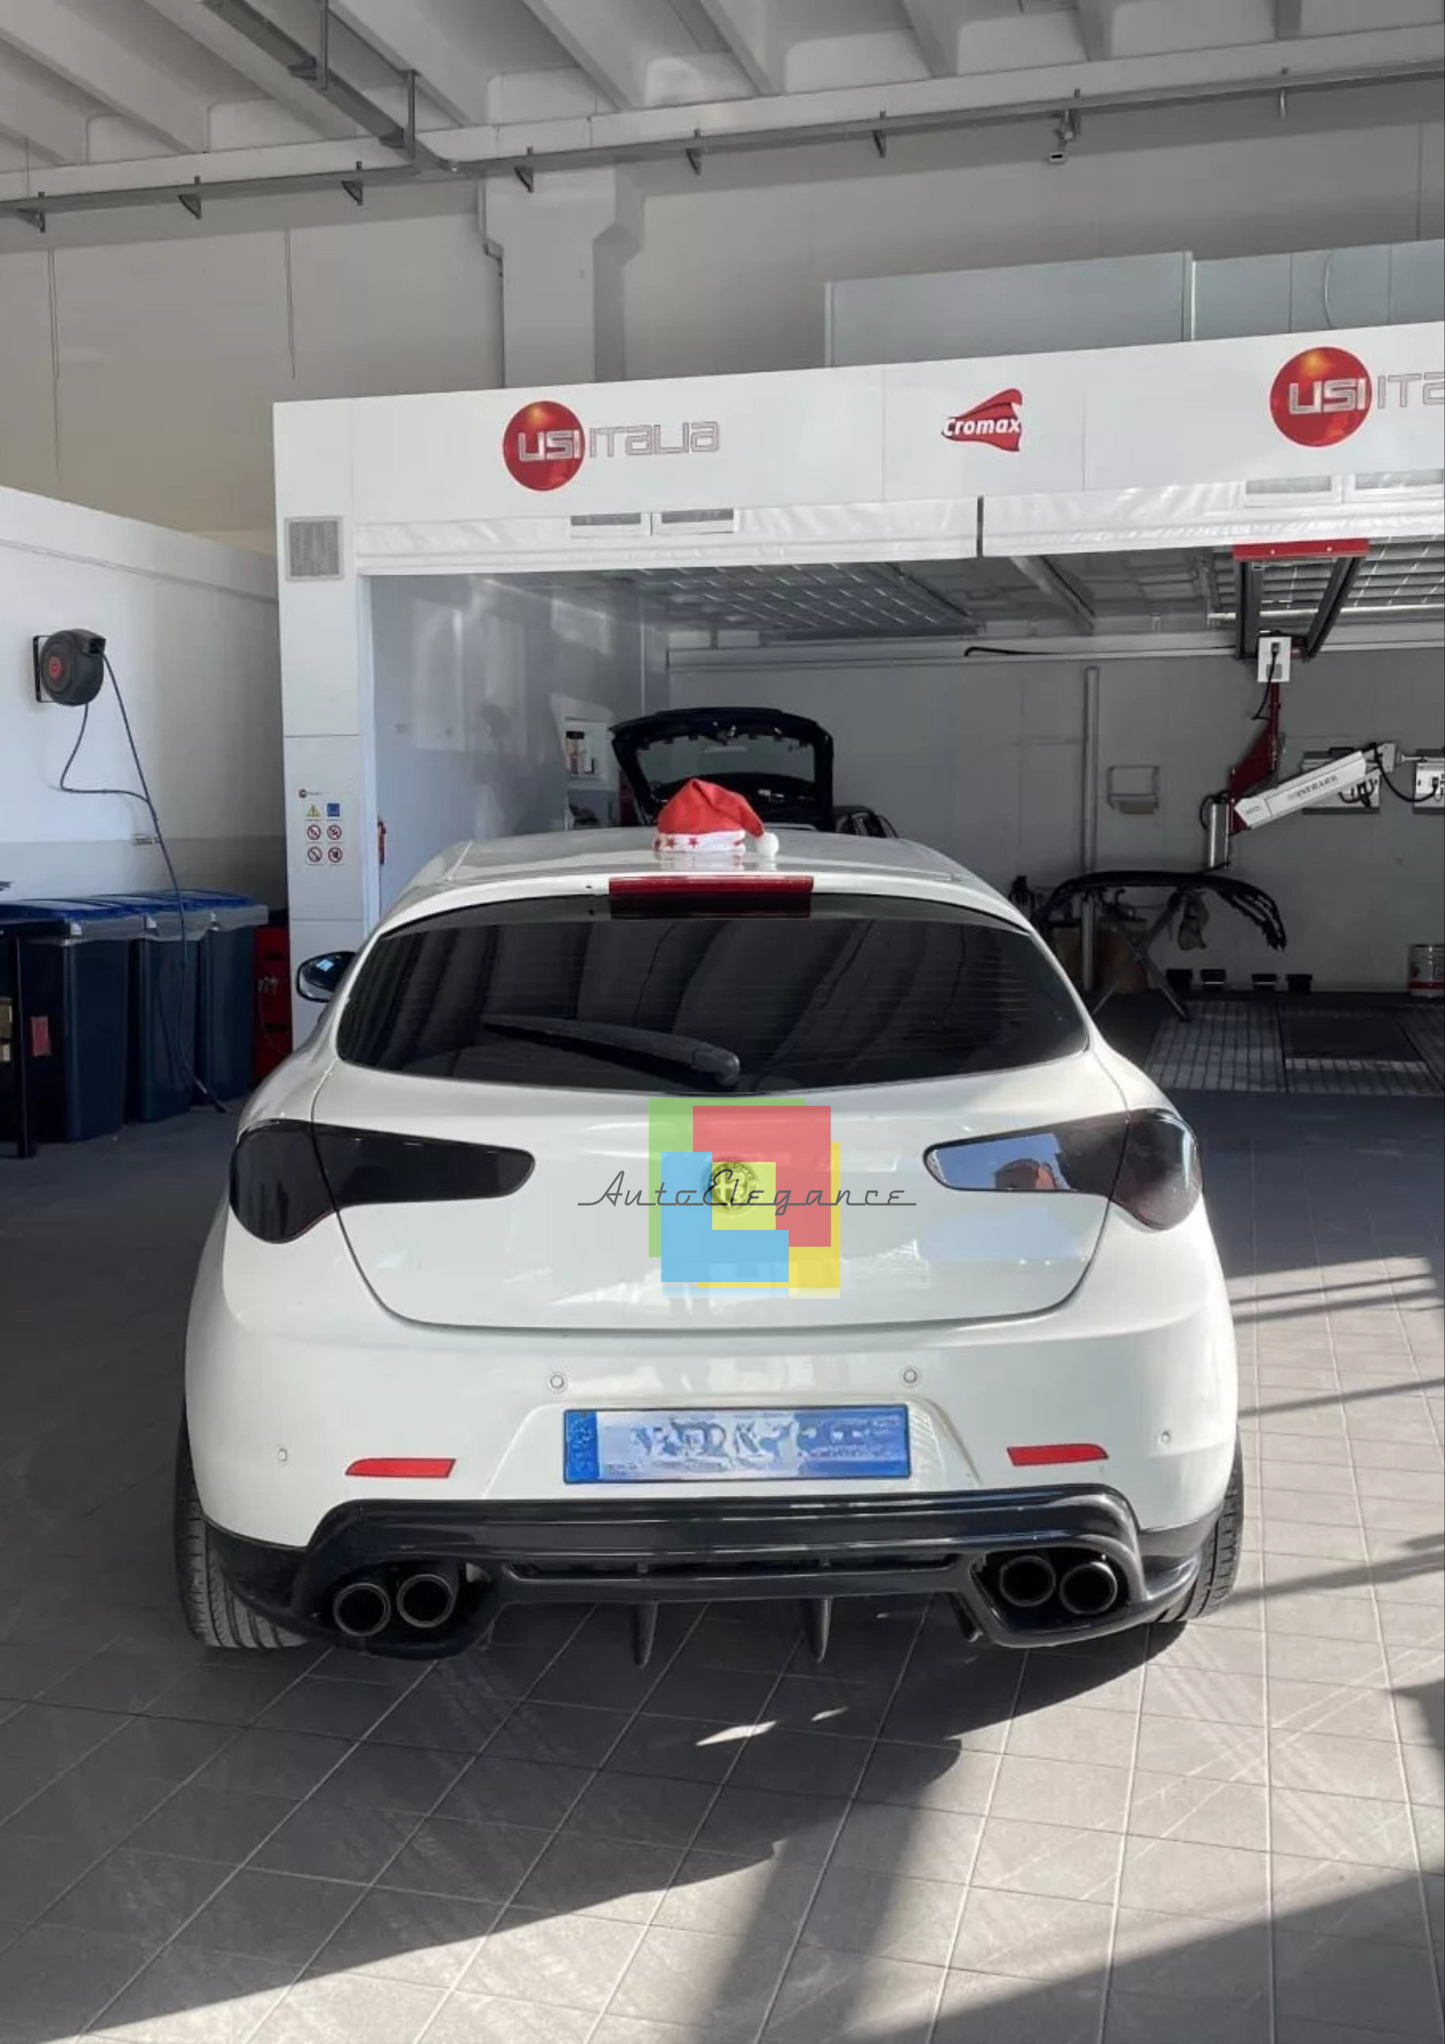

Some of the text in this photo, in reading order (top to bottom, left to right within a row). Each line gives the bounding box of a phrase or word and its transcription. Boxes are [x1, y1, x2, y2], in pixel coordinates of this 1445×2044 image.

[1288, 377, 1367, 416] USI
[942, 417, 1020, 437] Cromax
[517, 429, 581, 462] USI
